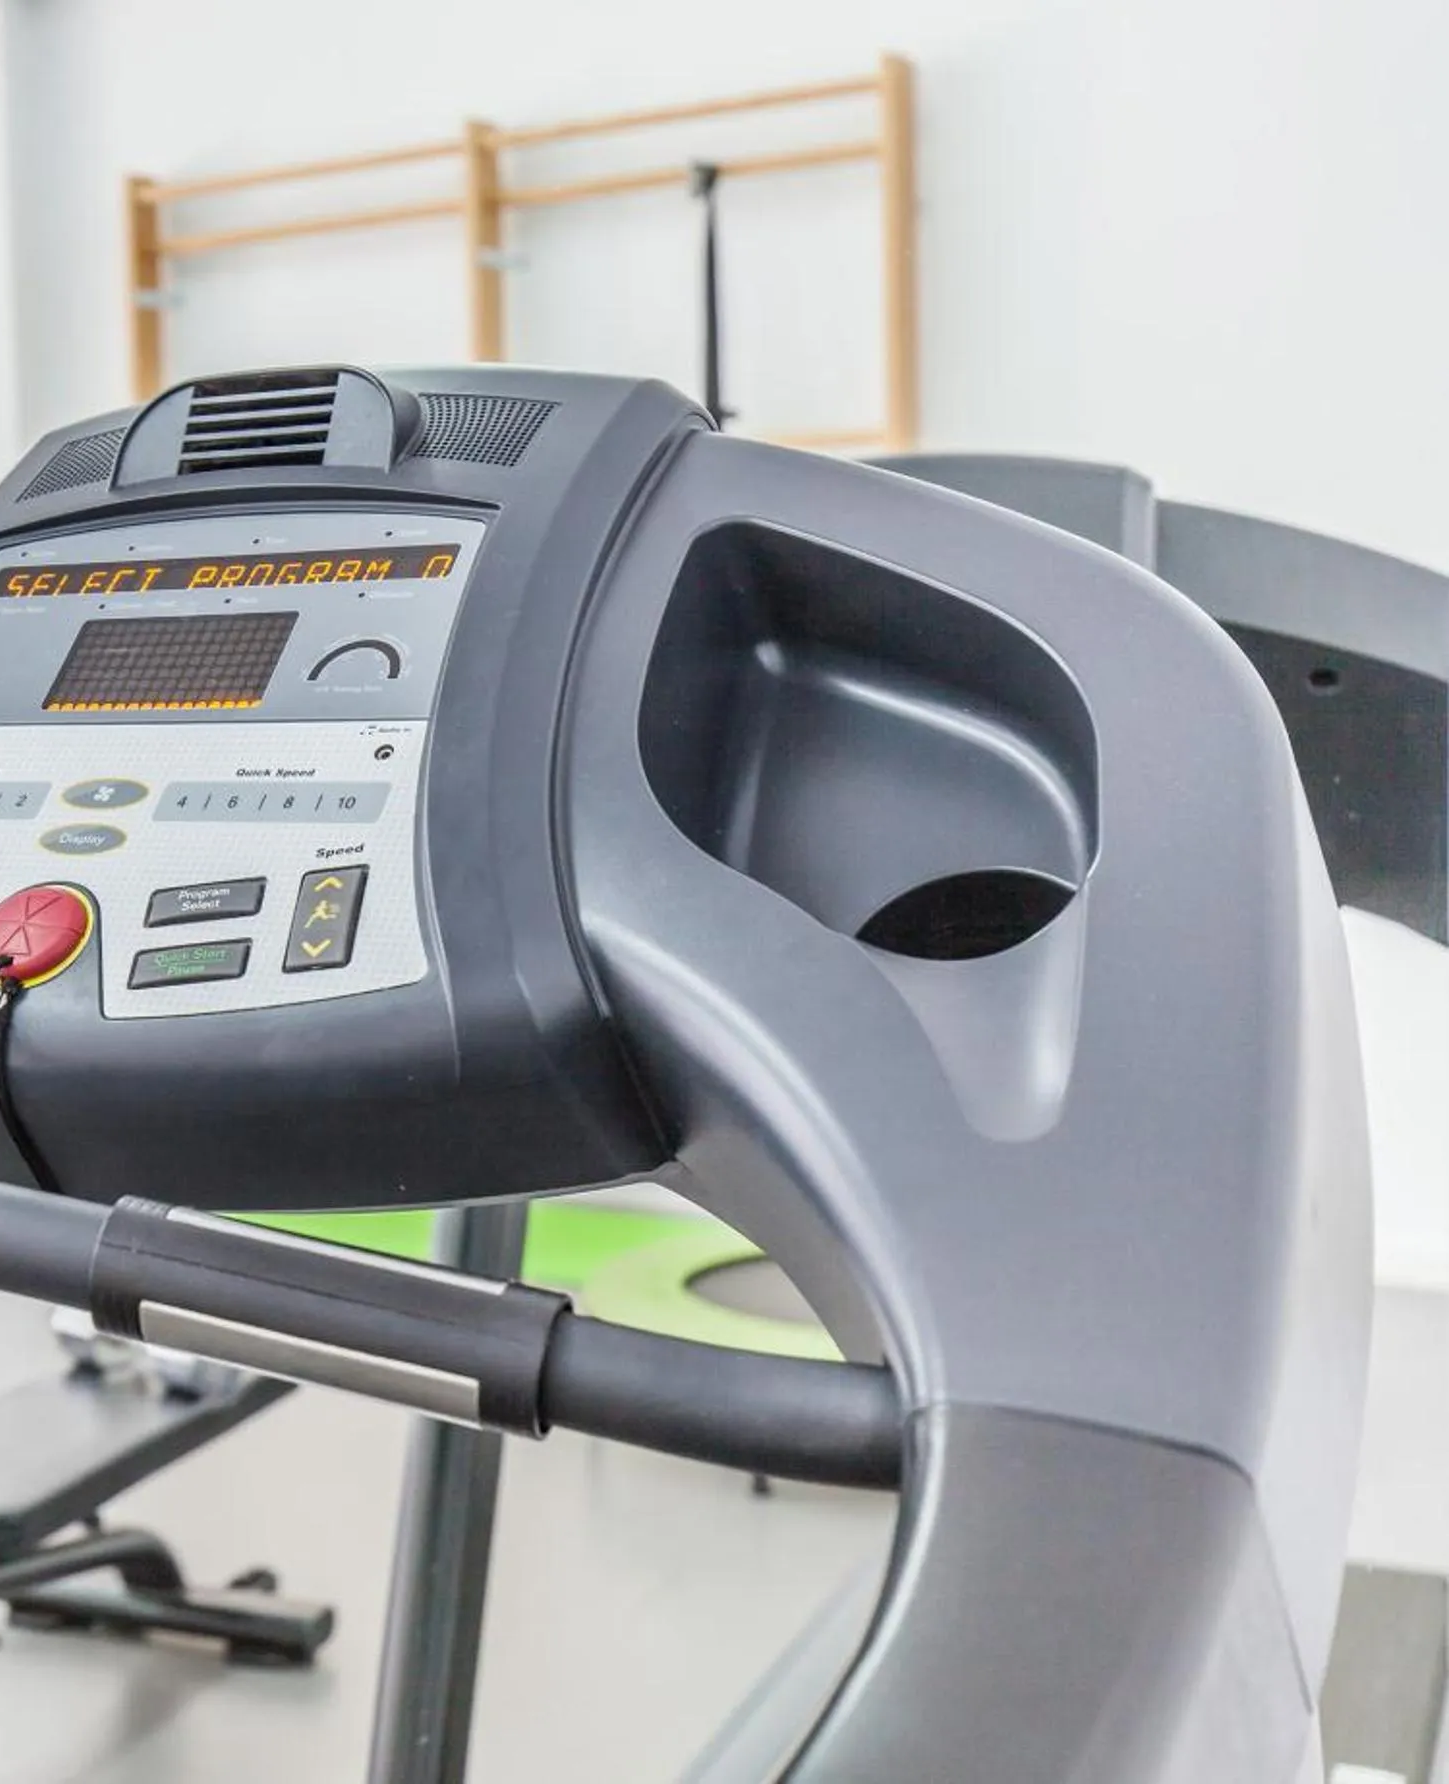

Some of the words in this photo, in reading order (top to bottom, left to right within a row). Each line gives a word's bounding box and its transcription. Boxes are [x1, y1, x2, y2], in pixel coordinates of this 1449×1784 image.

[7, 566, 164, 598] SELECT
[187, 559, 392, 589] PROGRAM
[235, 767, 272, 778] Quick
[274, 767, 317, 779] Speed
[14, 794, 28, 808] 2
[175, 794, 188, 809] 4
[226, 794, 241, 810] 6
[282, 795, 296, 810] 8
[337, 795, 357, 810] 10
[315, 842, 366, 859] Speed
[178, 888, 231, 902] Program
[181, 899, 221, 912] Select
